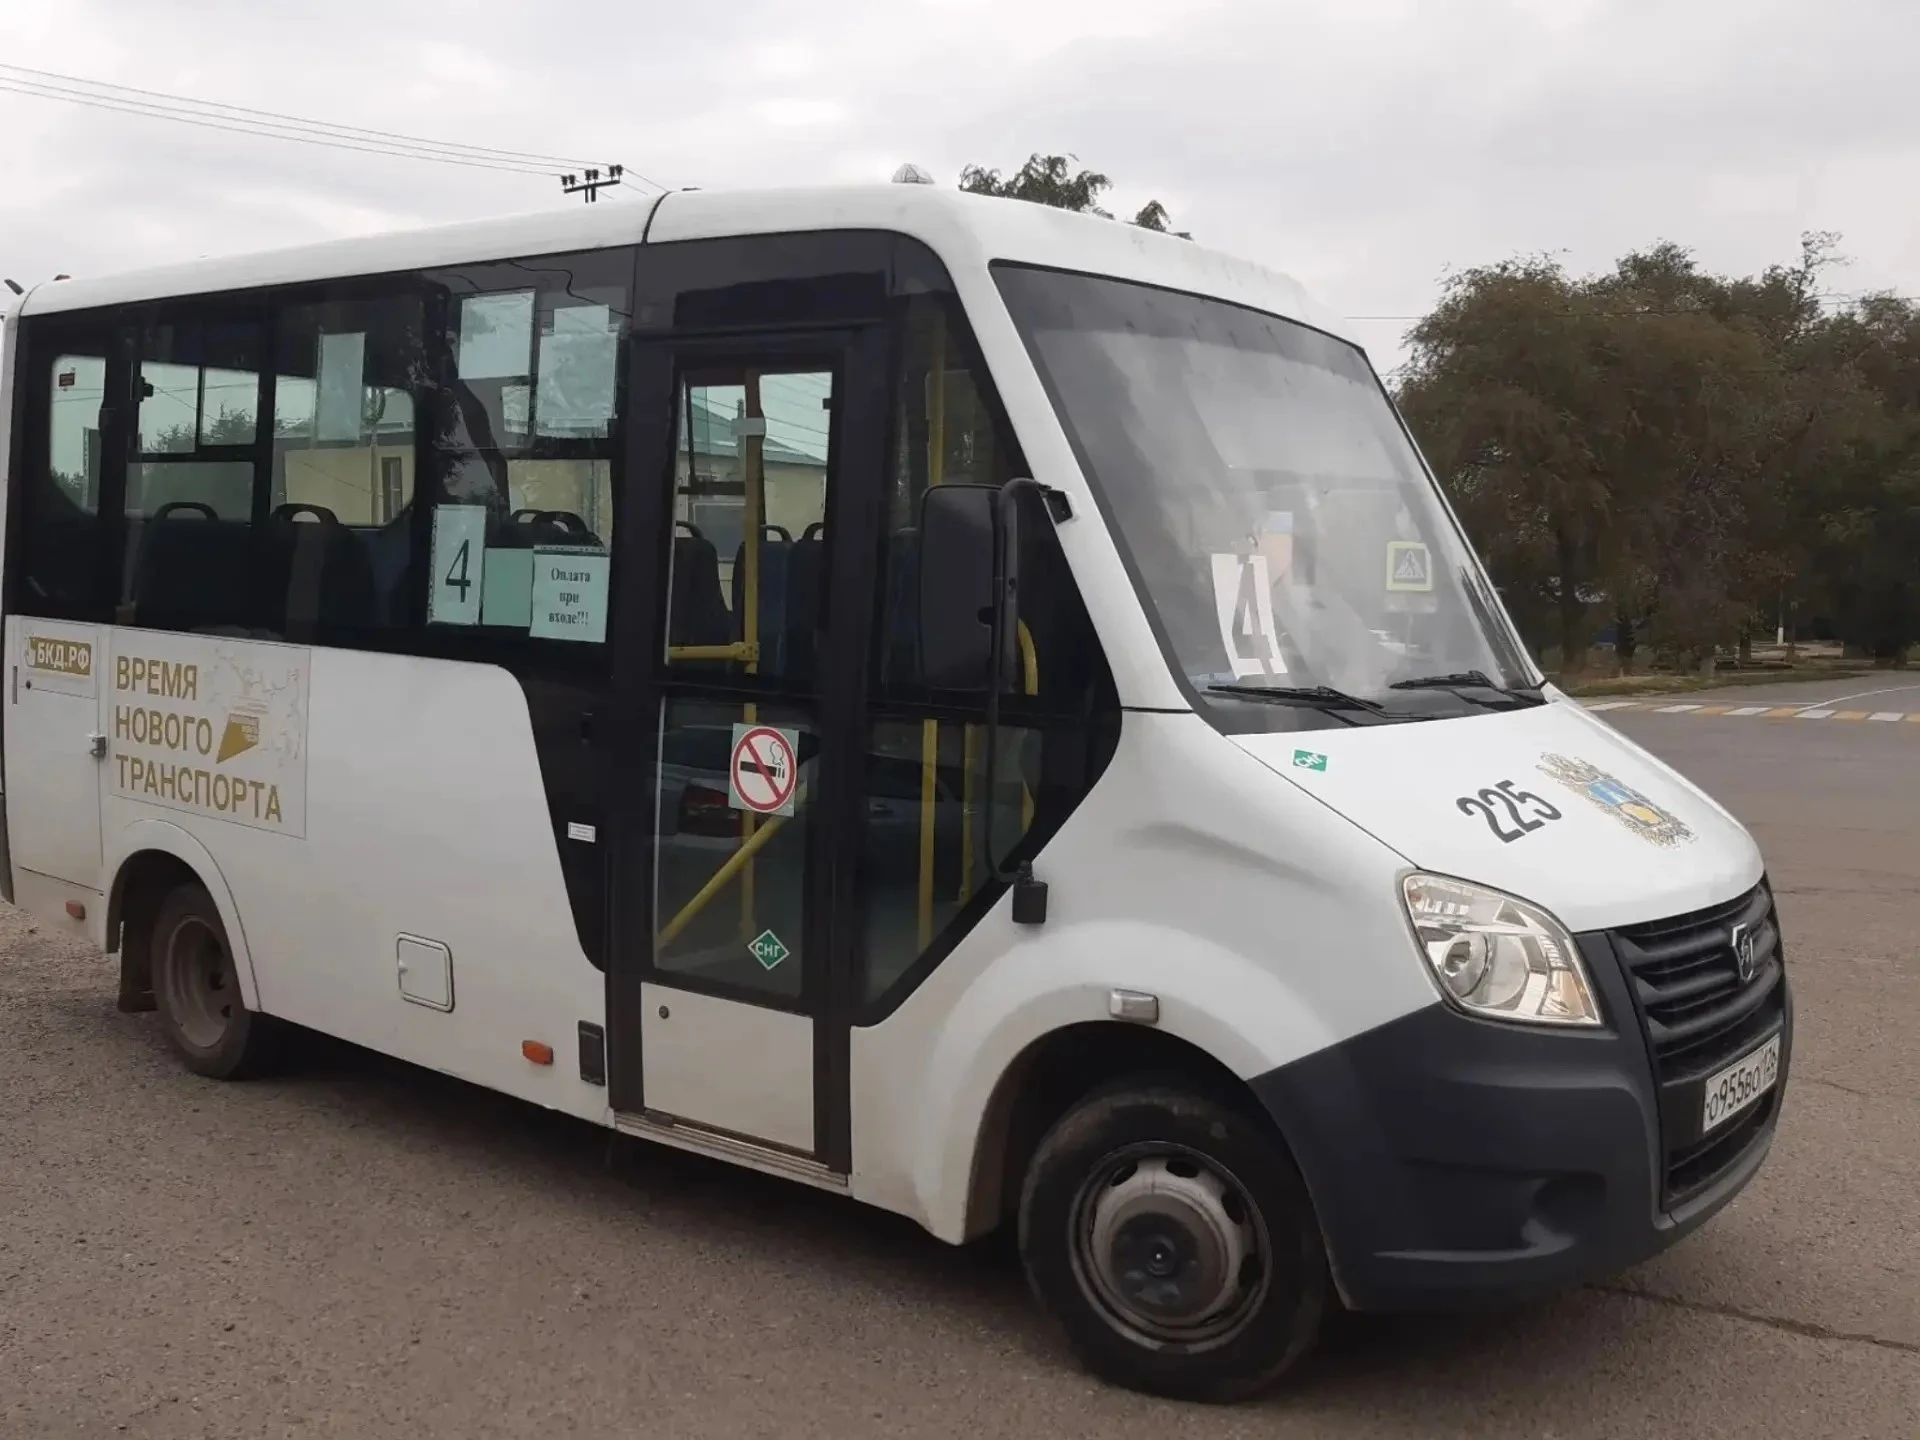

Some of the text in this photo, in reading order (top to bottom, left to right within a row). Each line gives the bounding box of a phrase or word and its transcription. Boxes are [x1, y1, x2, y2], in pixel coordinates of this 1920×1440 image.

[445, 538, 471, 603] 4
[551, 568, 591, 583] Оплата
[559, 592, 580, 606] при
[1231, 557, 1276, 674] 4
[37, 641, 90, 670] БКД.РФ
[116, 655, 198, 700] ВРЕМЯ
[115, 705, 213, 755] НОВОГО
[115, 754, 282, 823] ТРАНСПОРТА
[1456, 779, 1562, 843] 225
[755, 942, 781, 958] СНГ
